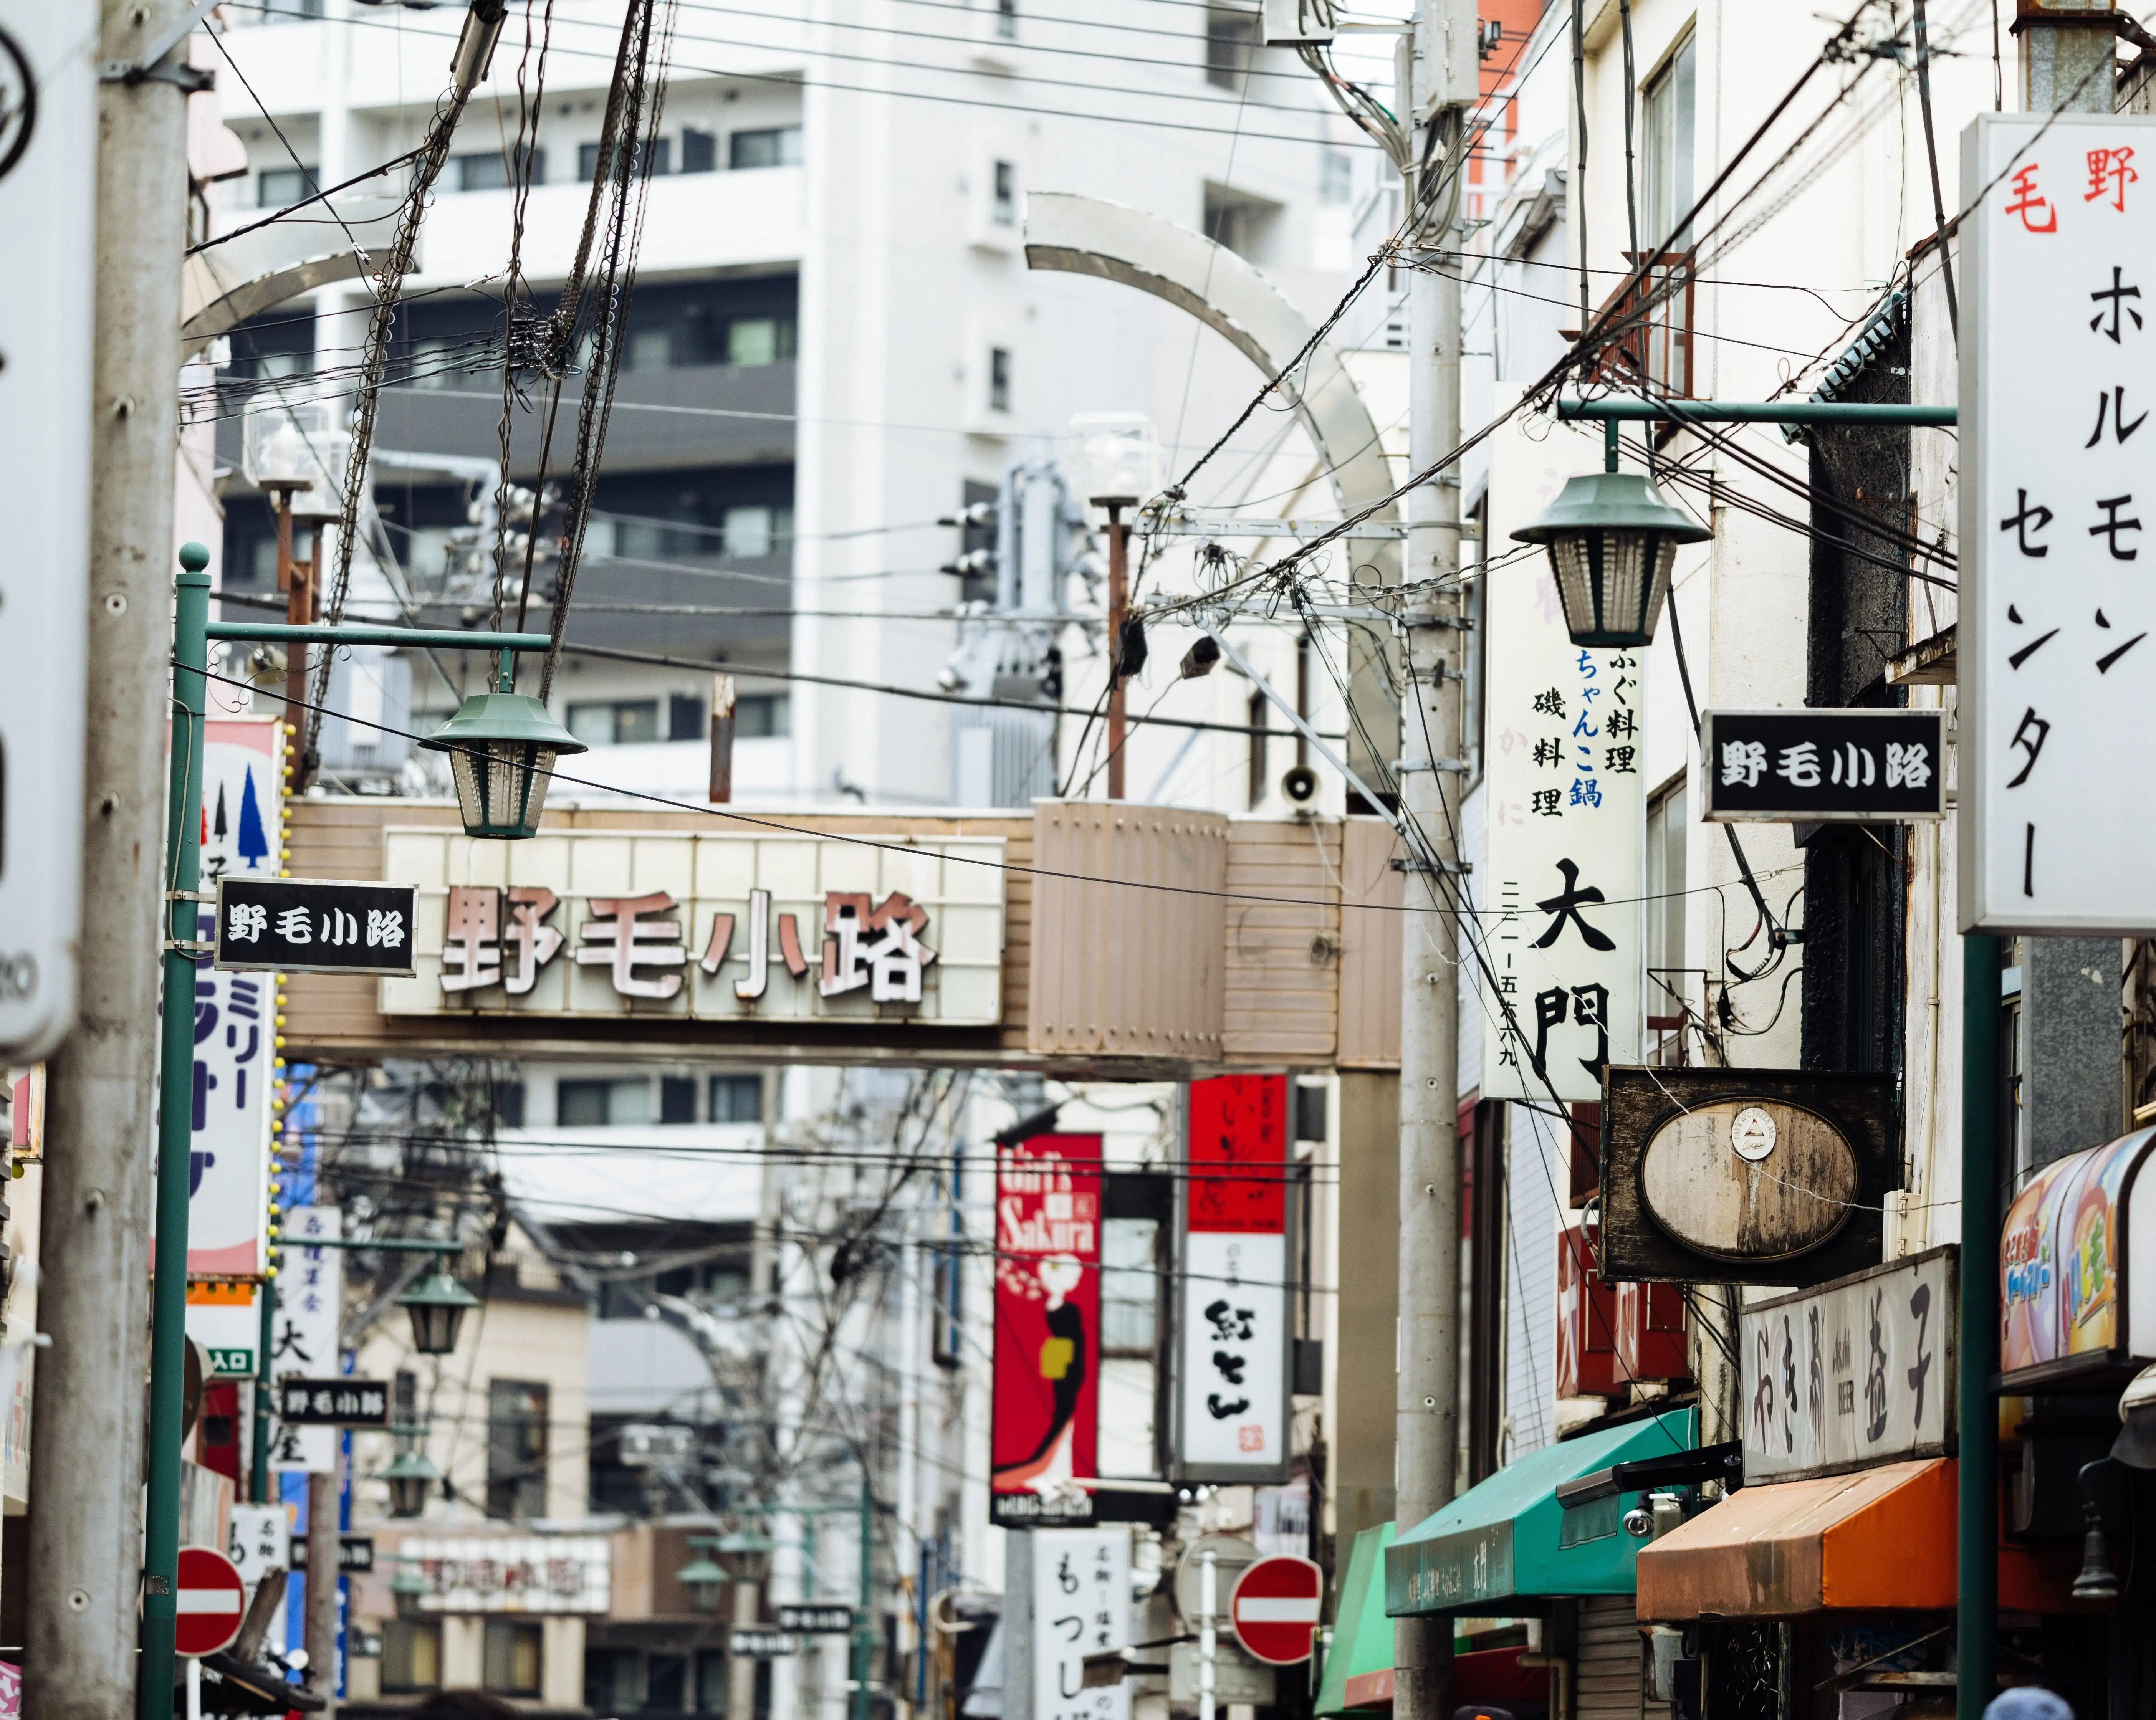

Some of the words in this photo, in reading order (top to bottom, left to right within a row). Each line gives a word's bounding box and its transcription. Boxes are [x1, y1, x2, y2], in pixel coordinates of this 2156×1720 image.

[2085, 266, 2149, 675] ホルモン
[1531, 686, 1566, 817] 磯料理
[1569, 649, 1602, 809] ちゃんこ鍋
[1604, 648, 1639, 774] ふぐ料理
[2001, 488, 2061, 898] センター
[1721, 740, 1932, 789] 野毛小路
[228, 903, 405, 948] 野毛小路
[438, 885, 939, 1005] 野毛小路
[1527, 857, 1617, 1085] 大門
[1742, 1140, 1766, 1150] Bass
[1838, 1380, 1855, 1416] BEER
